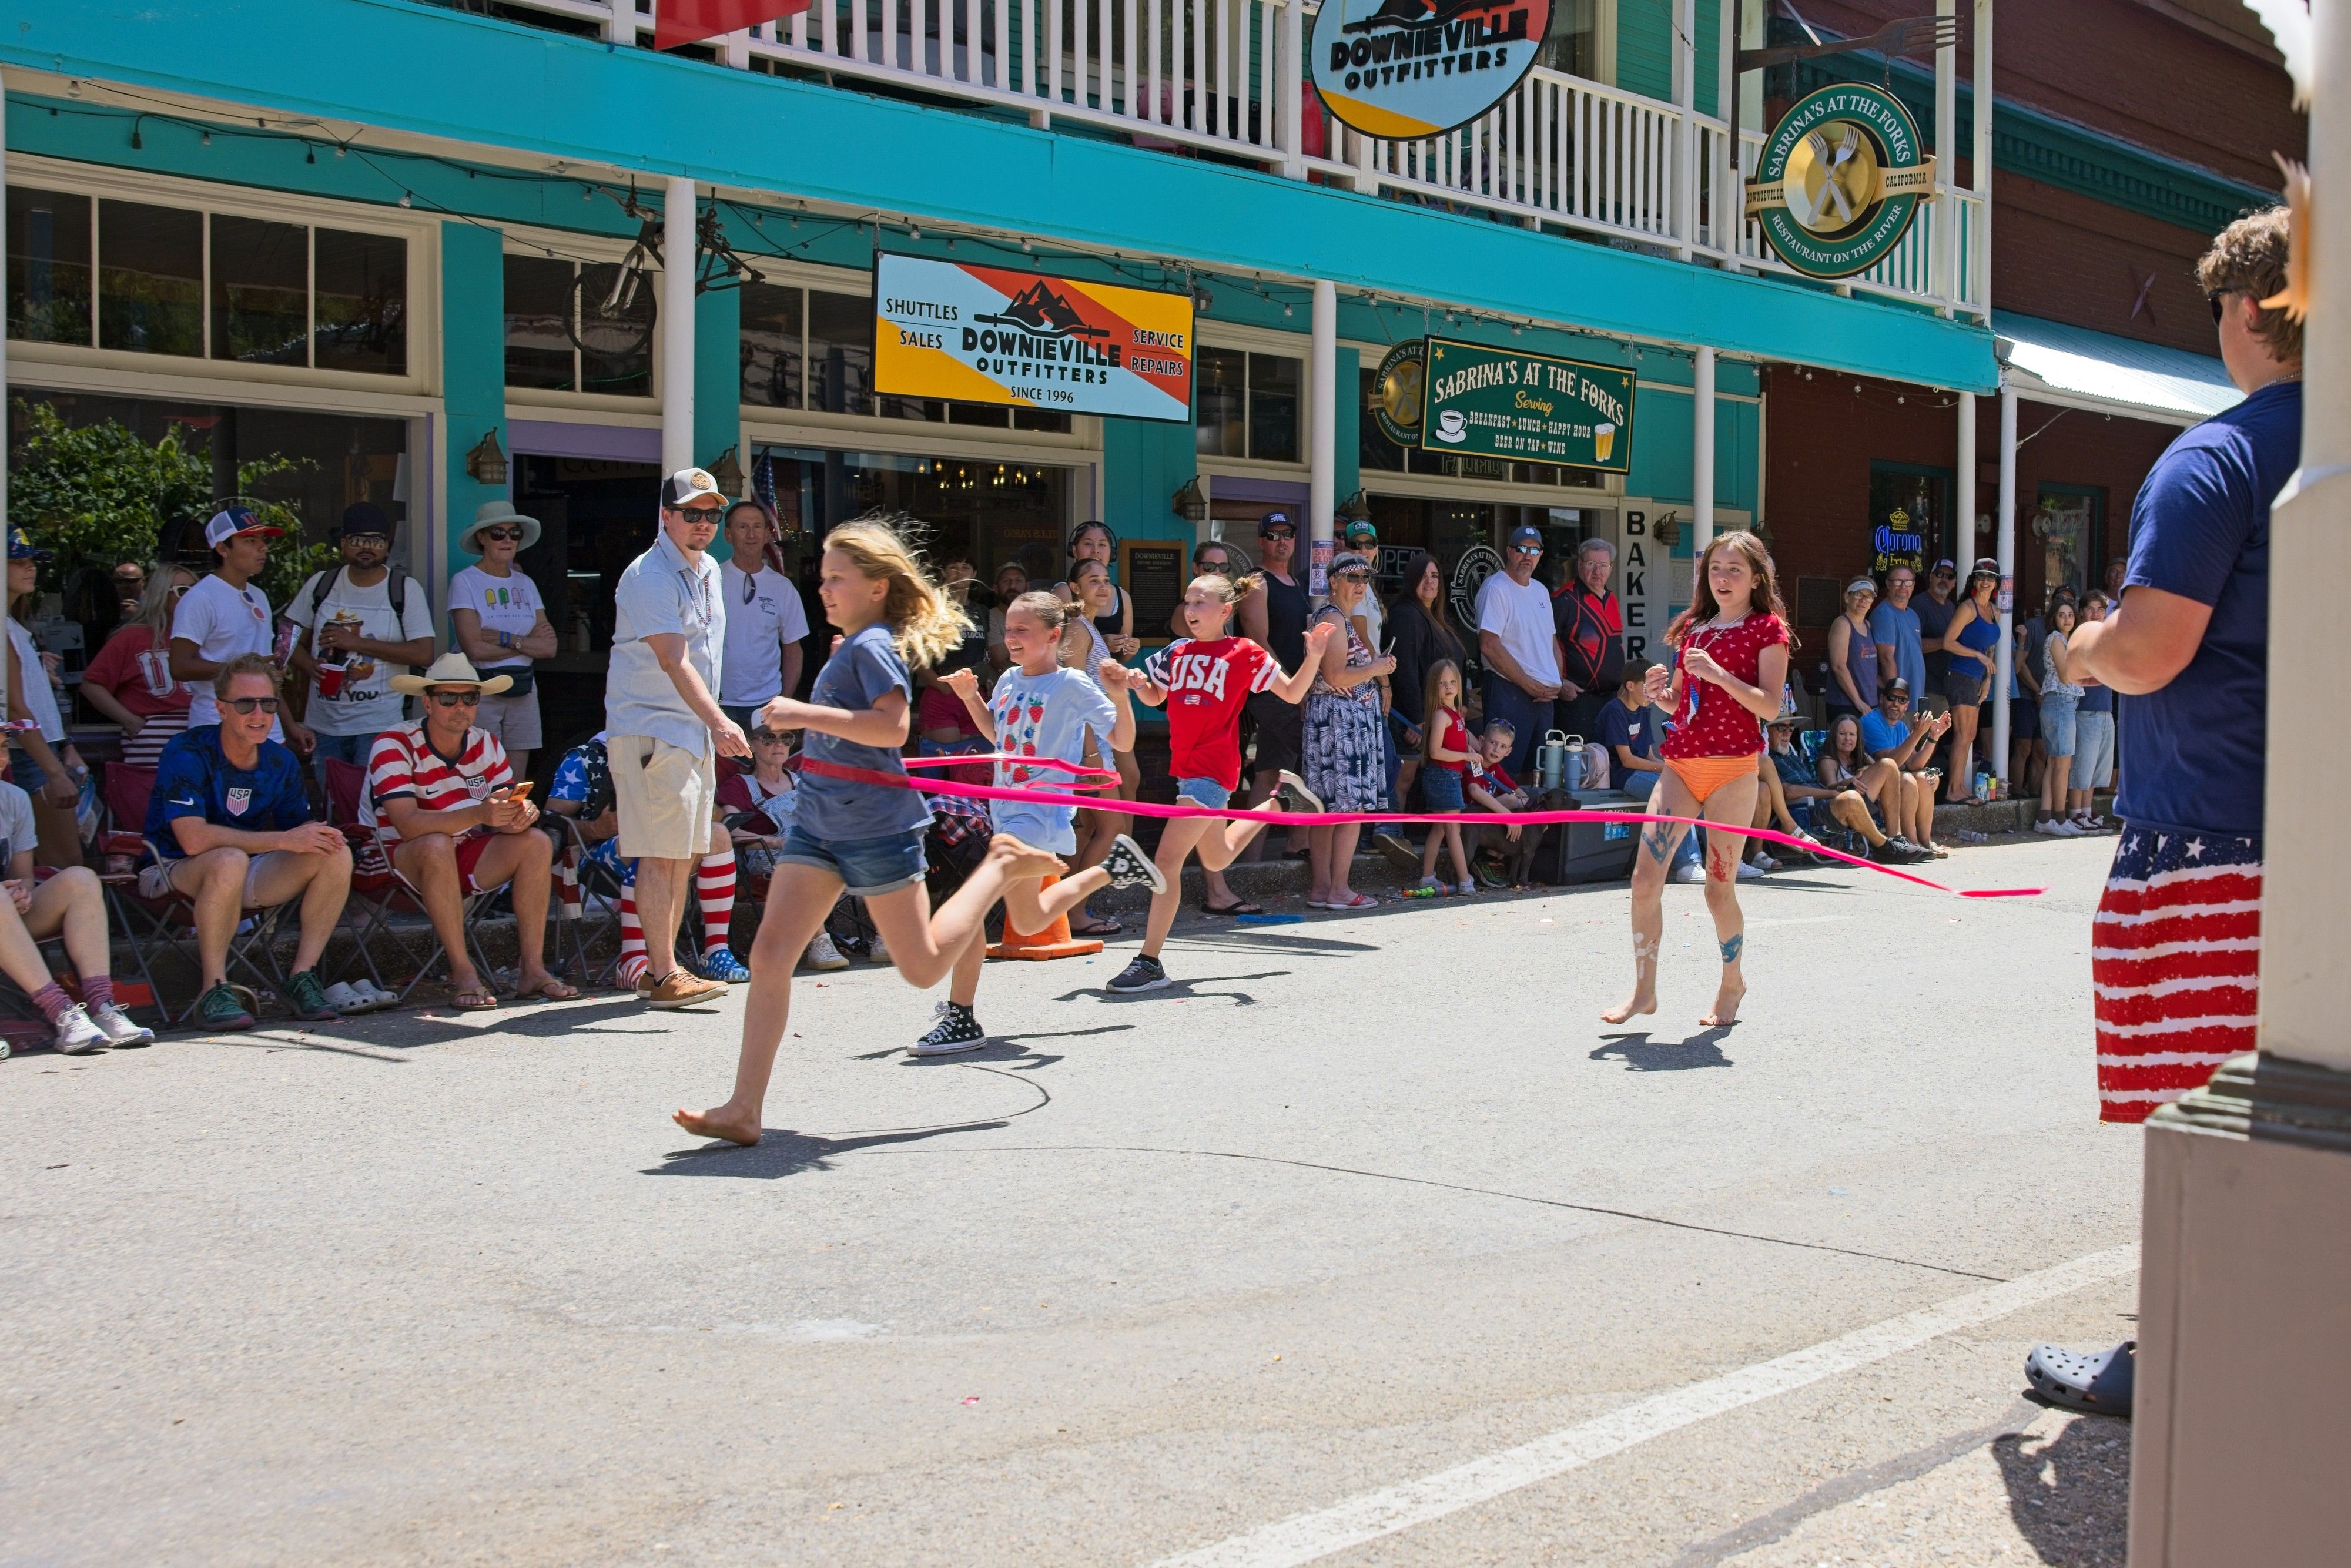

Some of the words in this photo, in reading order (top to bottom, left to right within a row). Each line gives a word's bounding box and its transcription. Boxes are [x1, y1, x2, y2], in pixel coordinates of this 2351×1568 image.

[1329, 9, 1528, 71] DOWNIEVILLE
[1344, 48, 1508, 91] OUTFITTERS
[1769, 100, 1825, 177] SABRINA'S
[1827, 95, 1846, 113] AT
[1850, 95, 1880, 119] THE
[1877, 109, 1910, 162] FORKS
[1886, 172, 1927, 188] CALIFORNIA
[1747, 188, 1783, 204] DOWNIEVILLE
[1772, 214, 1832, 263] RESTAURANT
[1833, 252, 1850, 263] ON
[1851, 241, 1874, 258] THE
[1873, 205, 1902, 243] RIVER
[885, 297, 958, 321] SHUTTLES
[899, 330, 942, 349] SALES
[962, 327, 1121, 368] DOWNIEVILLE
[1133, 329, 1184, 349] SERVICE
[976, 357, 1107, 385] OUTFITTERS
[1131, 356, 1184, 376] REPAIRS
[1378, 348, 1406, 389] SABRINA'S
[1407, 346, 1417, 355] AT
[1010, 386, 1043, 400] SINCE
[1046, 389, 1074, 403] 1996
[1435, 360, 1518, 404] SABRINA'S
[1523, 361, 1542, 386] AT
[1548, 365, 1576, 396] THE
[1580, 378, 1625, 427] FORKS
[1515, 390, 1555, 416] Serving
[1381, 411, 1412, 440] RESTAURANT
[1470, 411, 1511, 429] BREAKFAST
[1518, 418, 1541, 433] LUNCH
[1548, 421, 1572, 437] HAPPY
[1573, 425, 1591, 438] HOUR
[1495, 434, 1512, 448] BEER
[1515, 437, 1525, 450] ON
[1528, 438, 1540, 452] TAP
[1548, 441, 1566, 455] WINE
[1875, 525, 1922, 556] Corona
[1378, 547, 1425, 574] OPE
[1458, 552, 1478, 584] SABRINA'S
[1485, 552, 1495, 564] THE
[1170, 654, 1230, 701] USA
[347, 691, 379, 702] YOU
[230, 789, 249, 799] USA
[468, 777, 484, 787] USA
